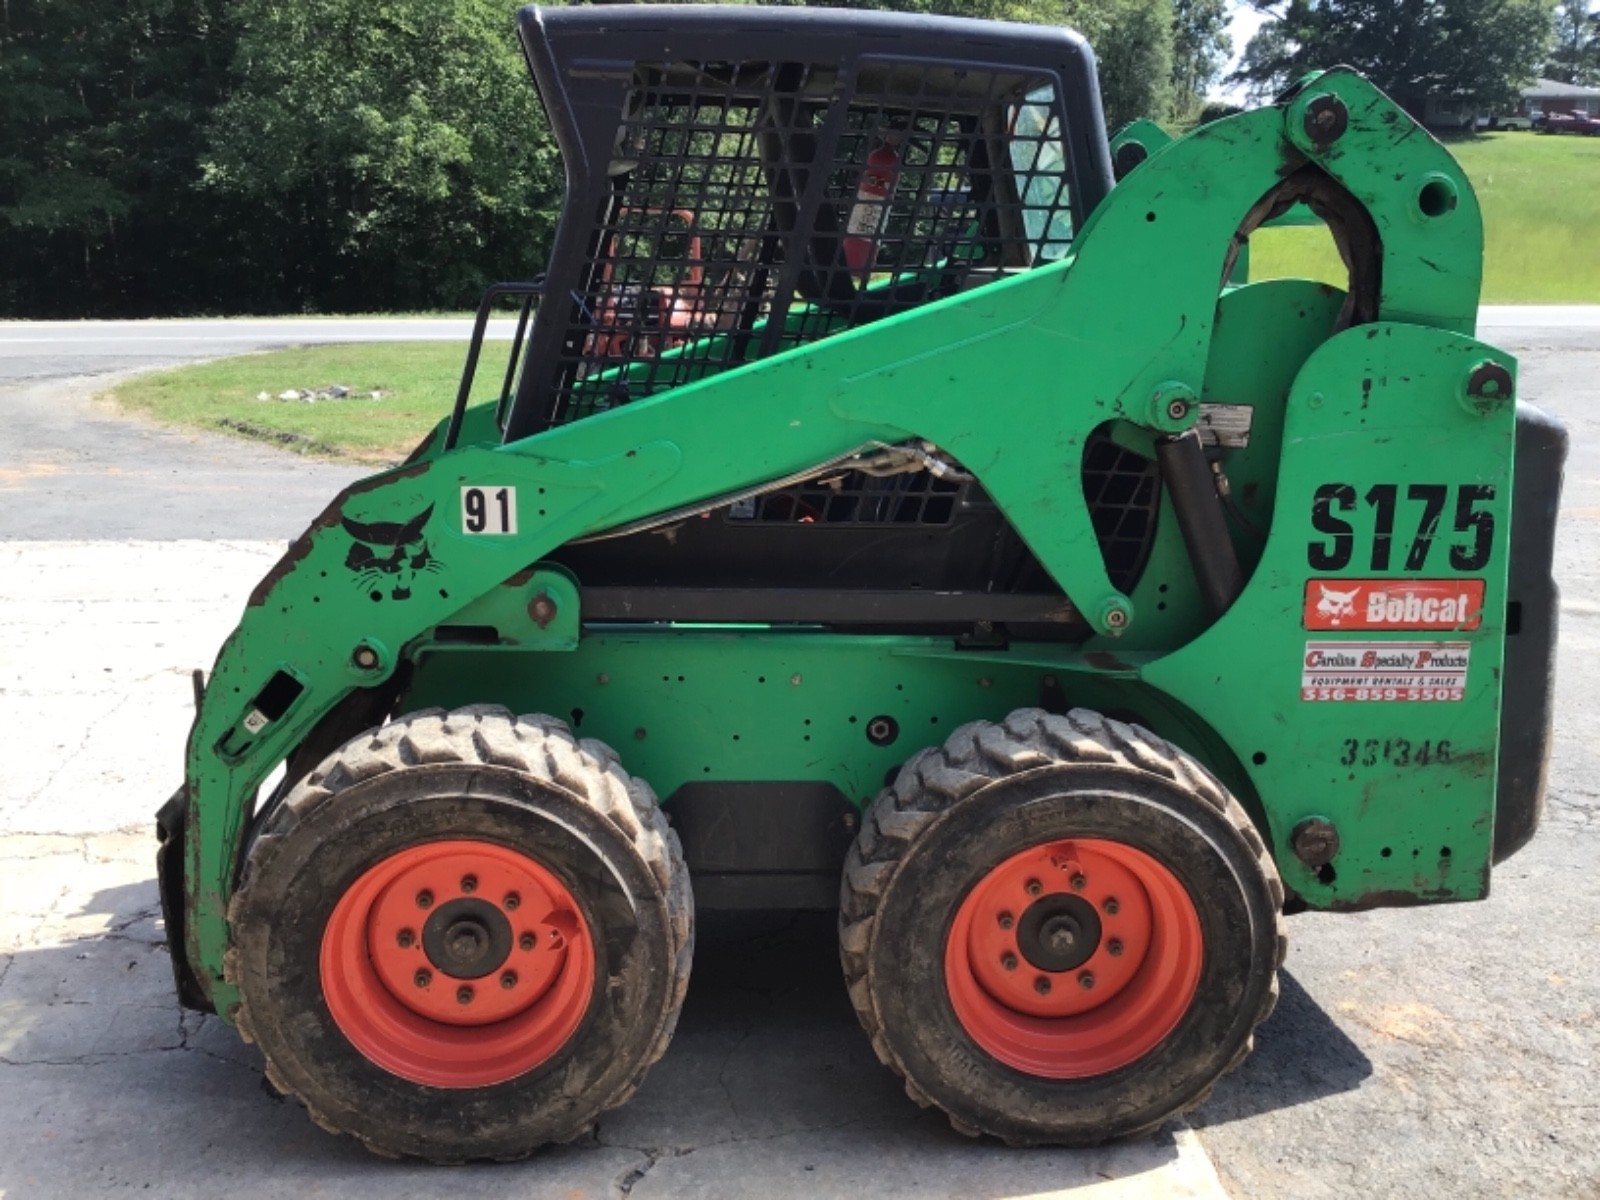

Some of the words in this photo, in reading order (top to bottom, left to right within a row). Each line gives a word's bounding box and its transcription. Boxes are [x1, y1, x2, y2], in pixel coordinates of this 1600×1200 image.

[465, 488, 509, 532] 91
[1307, 482, 1495, 571] S175
[1366, 592, 1469, 622] Bobcat
[1306, 651, 1356, 668] Carolina
[1360, 651, 1414, 669] Specialty
[1415, 651, 1467, 669] Products
